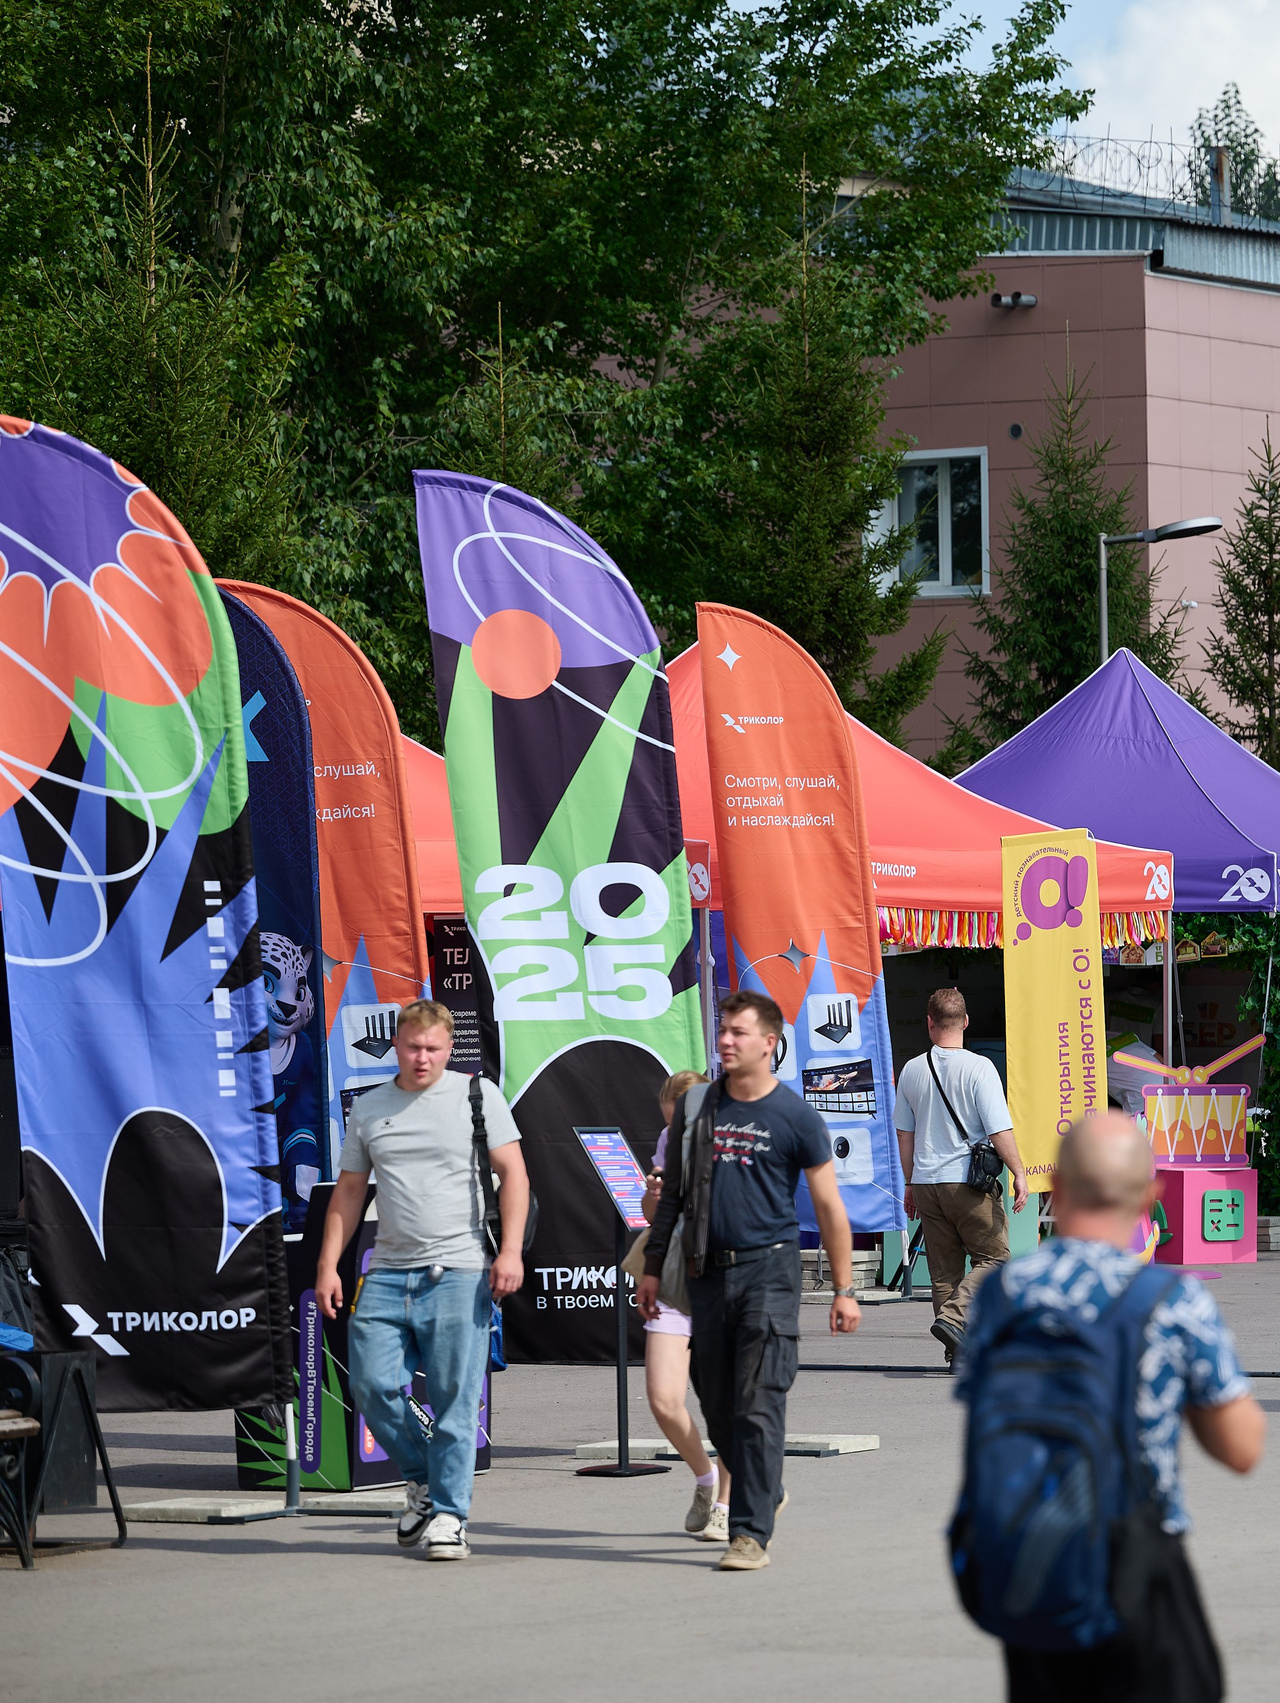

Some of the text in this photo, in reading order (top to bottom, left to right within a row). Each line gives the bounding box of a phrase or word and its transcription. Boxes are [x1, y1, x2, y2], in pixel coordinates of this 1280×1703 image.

[738, 716, 784, 725] ТРИКОЛОР
[313, 761, 381, 780] слушай,
[724, 774, 840, 791] Смотри, слушай,
[726, 793, 784, 809] отдыхай
[728, 813, 835, 829] и наслаждайся!
[870, 861, 917, 878] ТРИКОЛОР
[475, 862, 670, 940] 20
[489, 944, 674, 1022] 25
[1079, 979, 1091, 990] с
[1056, 1022, 1076, 1137] Открытия
[107, 1307, 257, 1332] ТРИКОЛОР
[305, 1301, 318, 1463] #ТриколорВТвоемГороде
